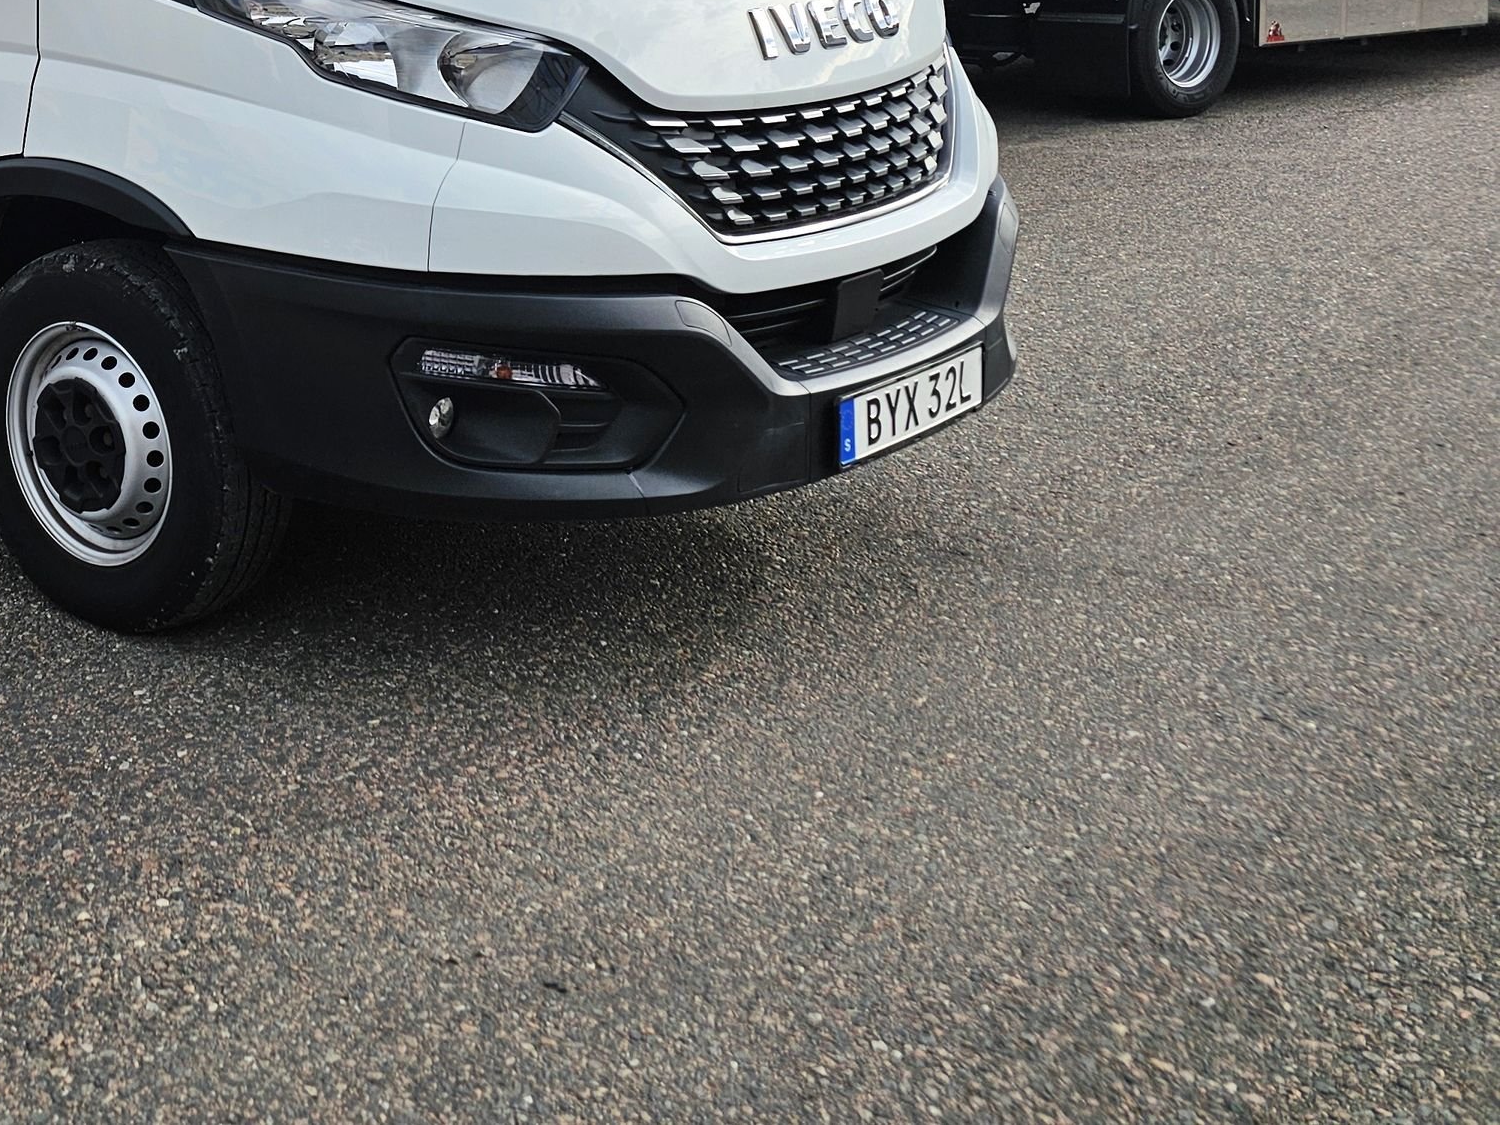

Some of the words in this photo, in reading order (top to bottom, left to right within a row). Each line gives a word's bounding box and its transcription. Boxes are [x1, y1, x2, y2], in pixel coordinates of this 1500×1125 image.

[866, 381, 919, 446] BYX
[928, 360, 972, 418] 32L
[844, 438, 851, 452] S
